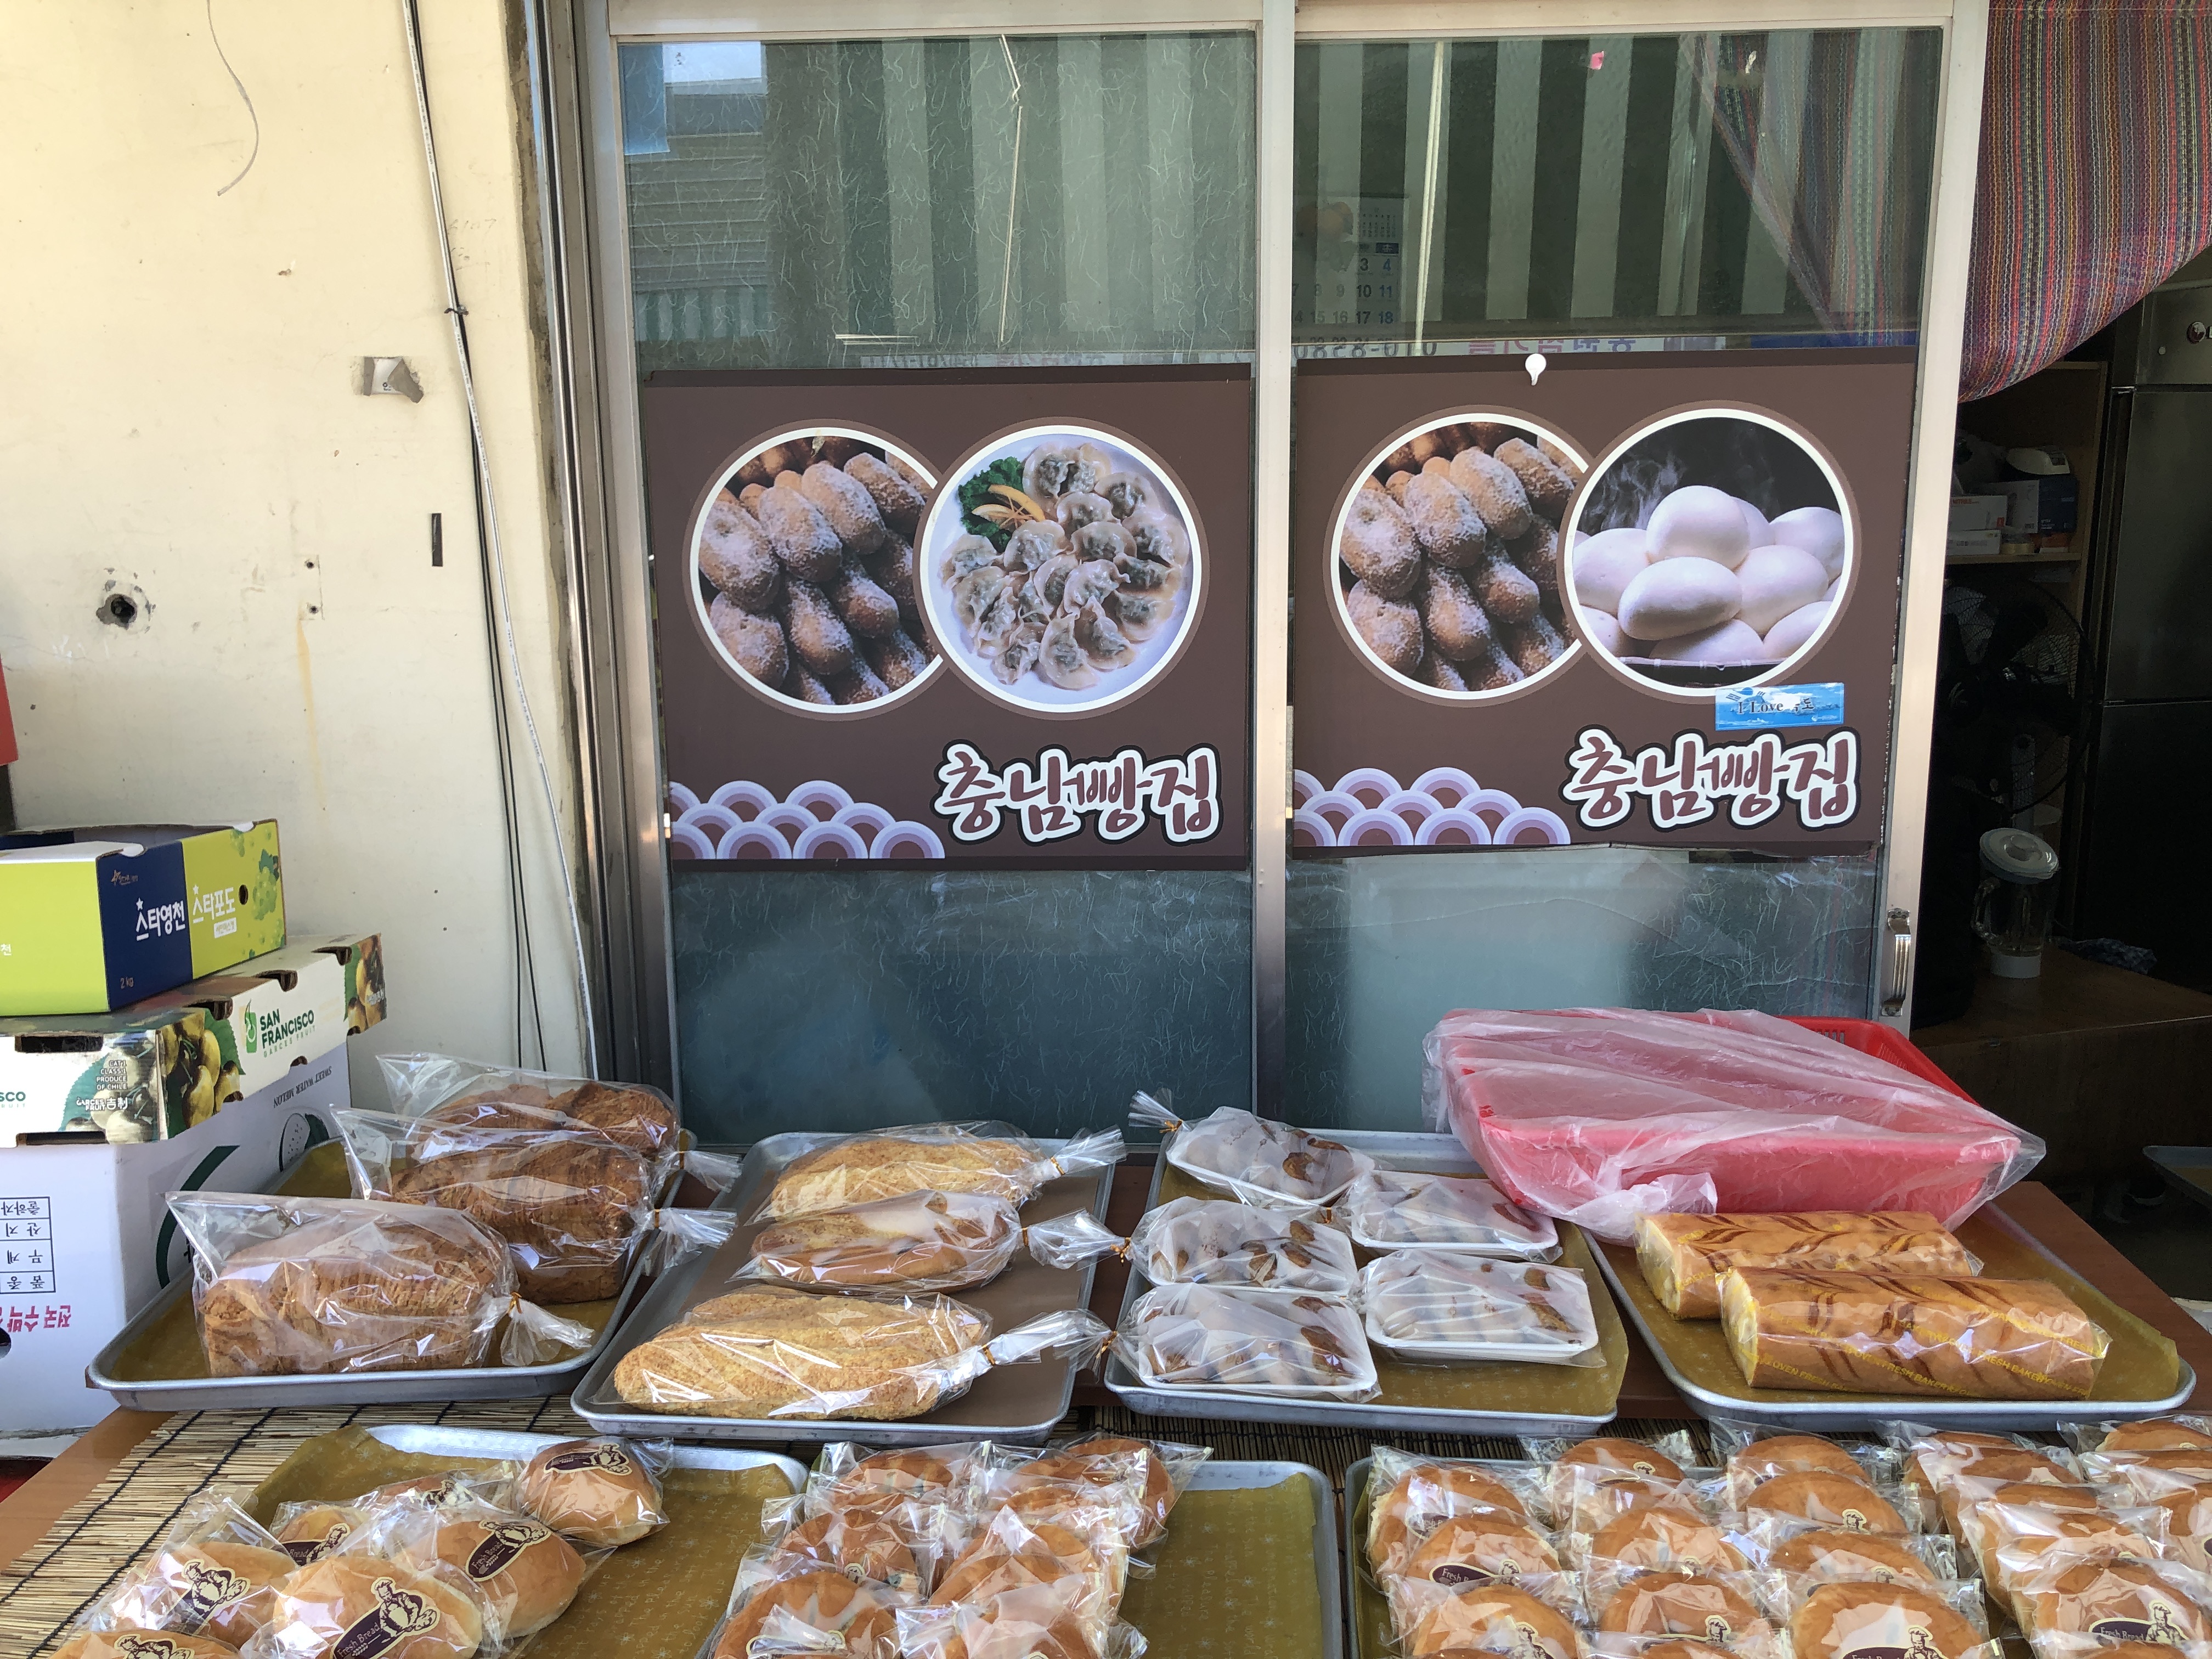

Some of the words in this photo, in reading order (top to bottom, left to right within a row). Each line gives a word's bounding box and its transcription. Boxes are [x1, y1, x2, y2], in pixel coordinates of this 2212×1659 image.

[1360, 258, 1369, 271] 3
[1383, 258, 1391, 271] 4
[1356, 285, 1372, 298] 10
[1380, 285, 1392, 298] 11
[1333, 311, 1348, 324] 16
[1356, 311, 1371, 324] 17
[1379, 311, 1393, 324] 18
[1751, 701, 1784, 713] Love
[1562, 729, 1857, 828] 충남빵집
[934, 744, 1217, 842] 충남빵집
[193, 887, 236, 924] 스타포도
[136, 899, 186, 941] 스타영천
[259, 1008, 280, 1031] SAN
[261, 1009, 314, 1049] FRANCISCO
[296, 1076, 314, 1092] WATER
[314, 1066, 332, 1084] SWEET
[273, 1087, 294, 1108] MELON
[1, 1200, 41, 1216] 출하자
[7, 1305, 40, 1333] 수박
[43, 1305, 71, 1328] 전국
[1441, 1568, 1462, 1582] Fresh
[336, 1640, 359, 1657] Fresh
[356, 1622, 380, 1643] Bread
